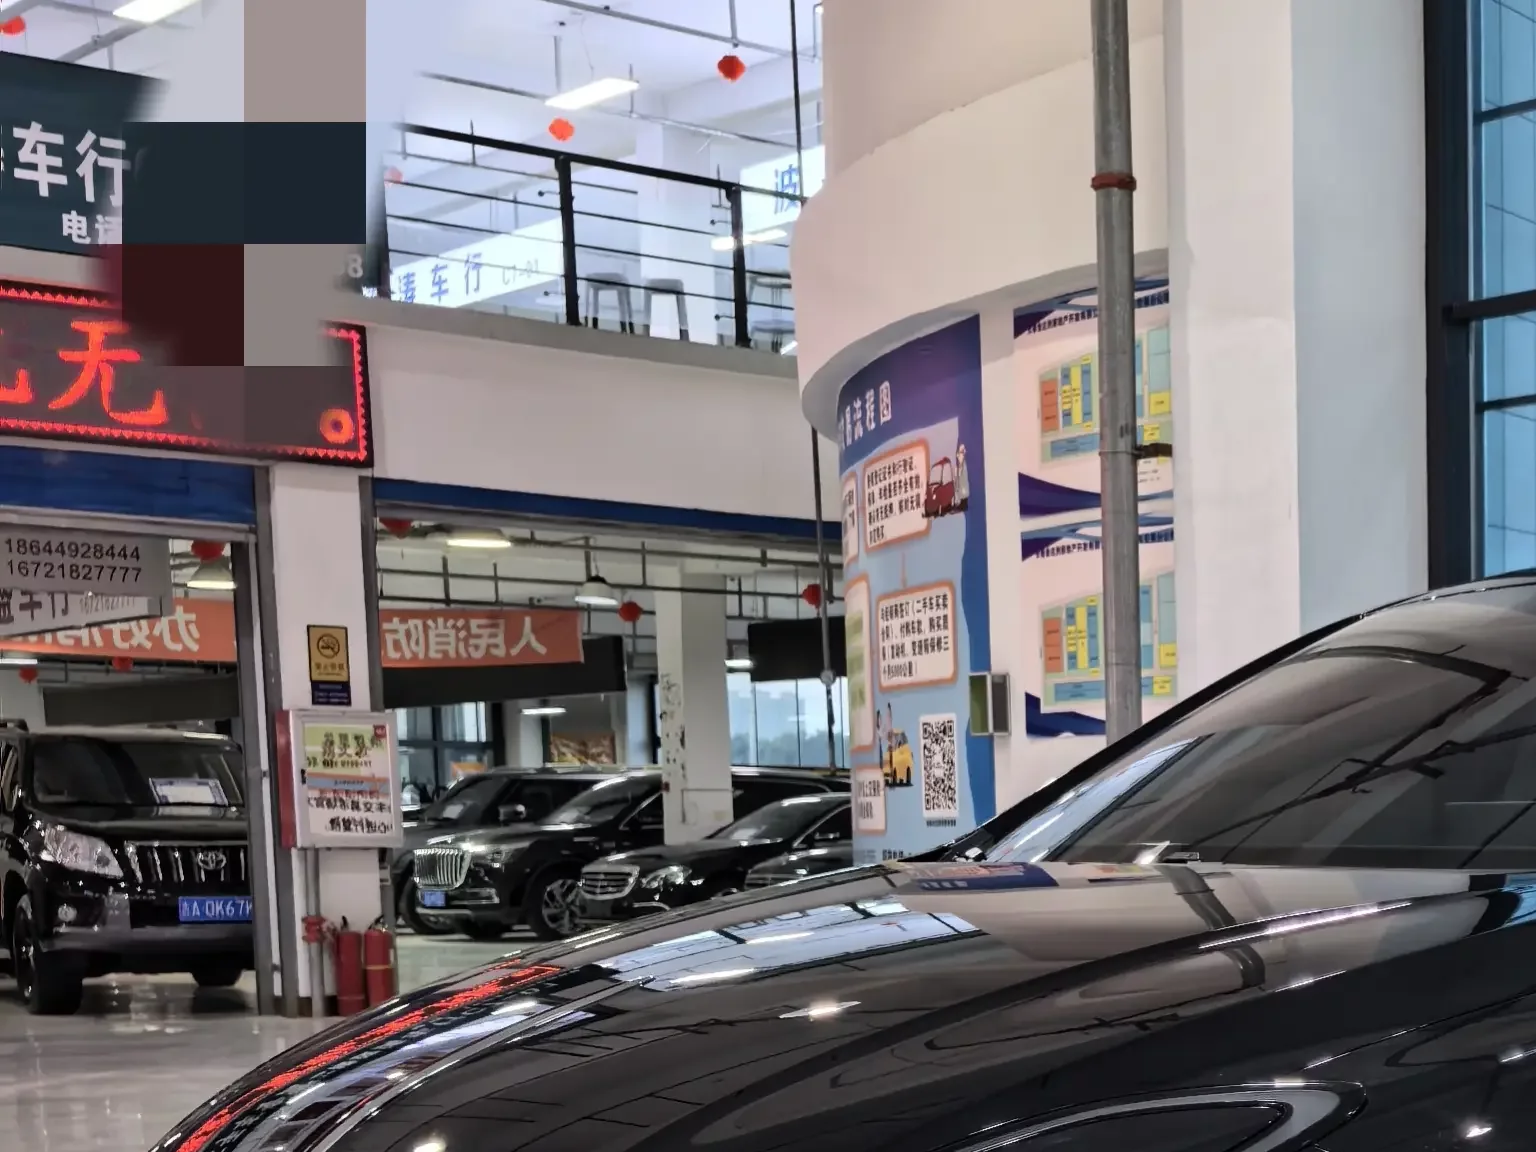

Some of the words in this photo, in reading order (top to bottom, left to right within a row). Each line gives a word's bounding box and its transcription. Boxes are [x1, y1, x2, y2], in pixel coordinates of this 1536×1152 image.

[0, 121, 131, 207] 车行
[5, 538, 141, 562] 18644928444
[7, 560, 142, 583] 16721827777
